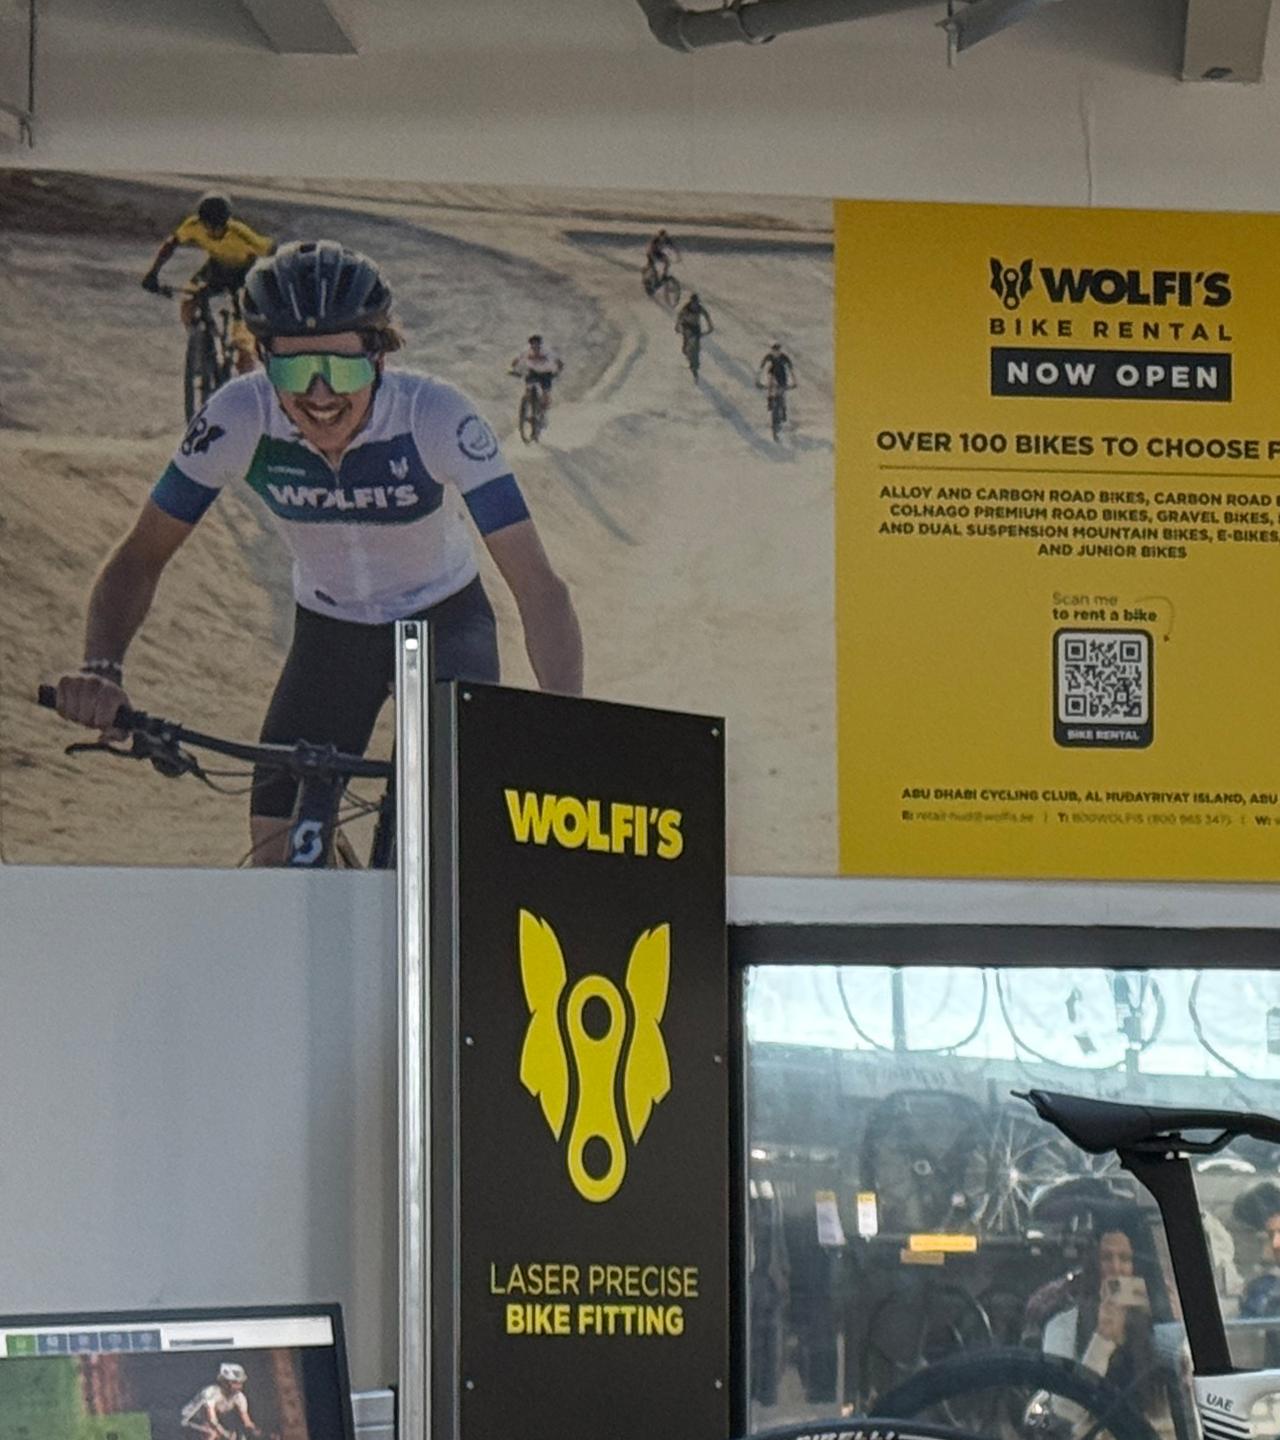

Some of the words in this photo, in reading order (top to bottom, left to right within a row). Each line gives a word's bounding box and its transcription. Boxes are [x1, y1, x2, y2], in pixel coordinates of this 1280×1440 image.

[1040, 268, 1232, 307] WOLFI'S
[989, 318, 1073, 338] BIKE
[1093, 321, 1233, 342] RENTAL
[1007, 360, 1096, 386] NOW
[1116, 364, 1219, 389] OPEN
[876, 431, 952, 454] OVER
[959, 432, 1007, 454] 100
[1015, 434, 1095, 457] BIKES
[1101, 436, 1139, 457] TO
[1146, 437, 1260, 460] CHOOSE
[880, 485, 933, 499] ALLOY
[937, 487, 972, 500] AND
[976, 488, 1045, 502] CARBON
[1050, 489, 1095, 503] ROAD
[1099, 490, 1149, 506] BIKES,
[1154, 492, 1222, 506] CARBON
[1226, 493, 1272, 507] ROAD
[890, 503, 970, 518] COLNAGO
[974, 505, 1048, 519] PREMIUM
[1052, 507, 1098, 520] ROAD
[1102, 508, 1153, 524] BIKES,
[1156, 510, 1220, 524] GRAVEL
[1224, 511, 1274, 526] BIKES,
[879, 521, 914, 535] AND
[918, 523, 963, 536] DUAL
[966, 524, 1068, 539] SUSPENSION
[1072, 526, 1159, 541] MOUNTAIN
[1162, 528, 1213, 543] BIKES,
[1038, 543, 1073, 557] AND
[1077, 545, 1137, 558] JUNIOR
[1140, 545, 1188, 559] BIKES
[1053, 591, 1090, 606] Scan
[1094, 594, 1118, 606] me
[1053, 608, 1069, 621] to
[1074, 608, 1106, 621] rent
[1110, 612, 1119, 621] a
[1124, 609, 1157, 622] bike
[902, 787, 930, 800] ABU
[981, 789, 1039, 802] CYCLING
[504, 787, 685, 860] WOLFI'S
[490, 1262, 580, 1297] LASER
[588, 1265, 699, 1298] PRECISE
[506, 1303, 571, 1335] BIKE
[578, 1304, 685, 1336] FITTING
[1206, 1392, 1234, 1412] UAE
